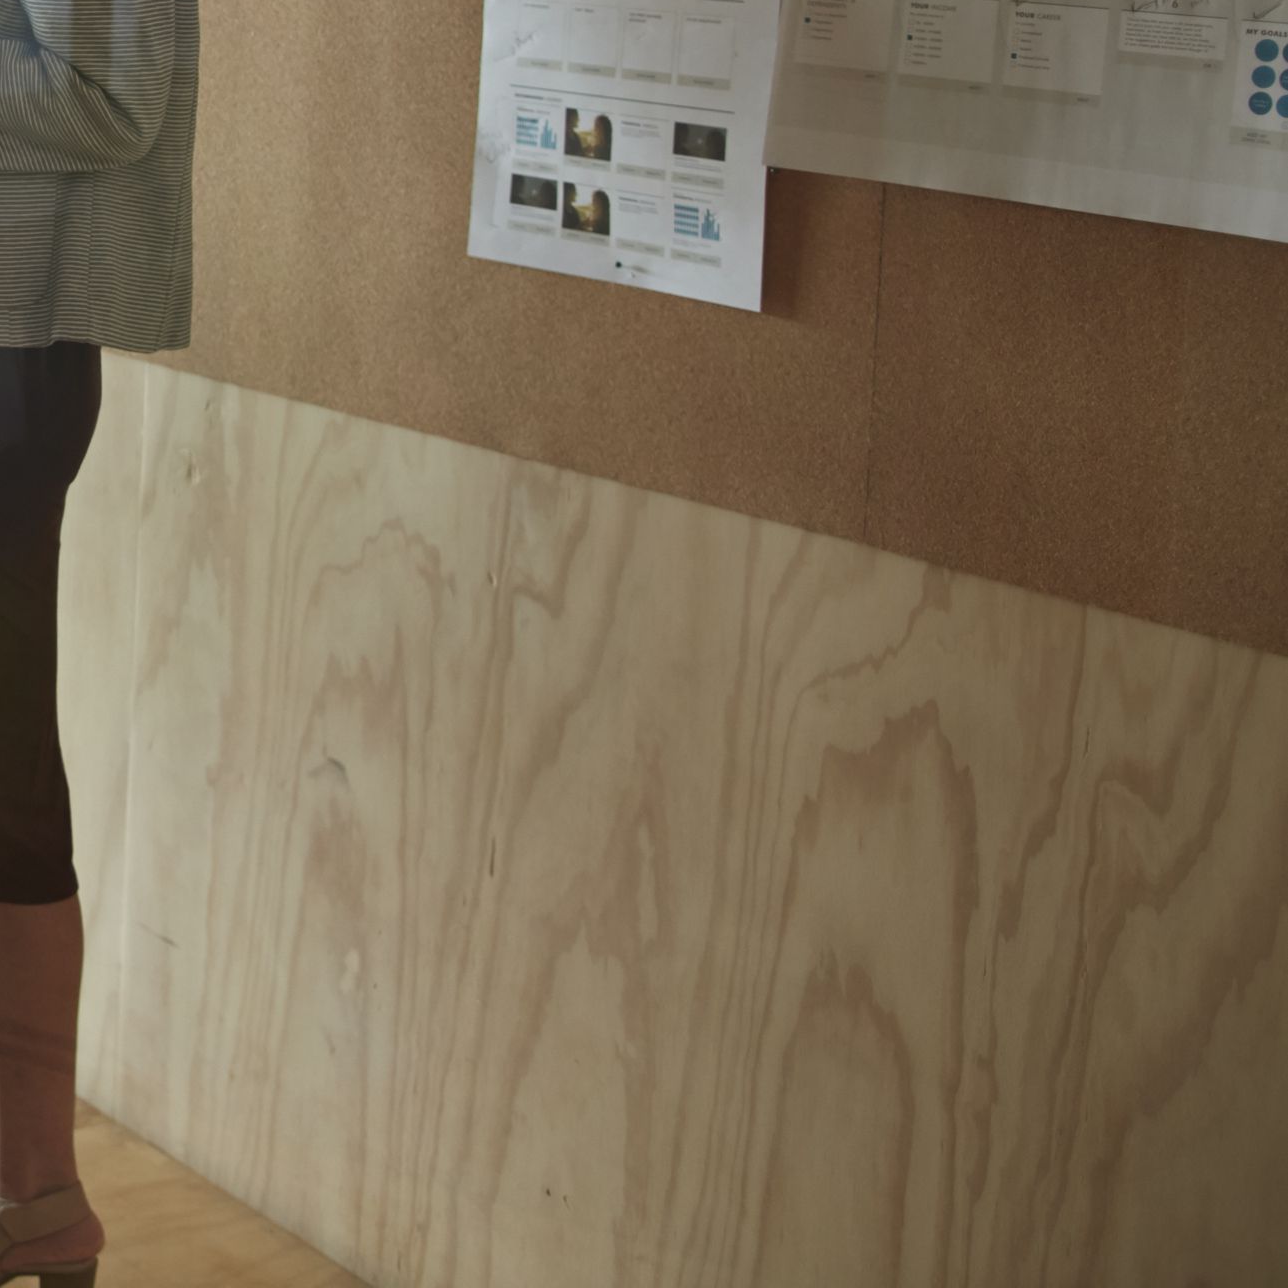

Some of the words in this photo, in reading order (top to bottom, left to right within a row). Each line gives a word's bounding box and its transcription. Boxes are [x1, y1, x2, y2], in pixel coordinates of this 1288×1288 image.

[911, 2, 929, 10] YOUR
[1171, 0, 1179, 8] 6
[1016, 11, 1035, 19] YOUR
[1036, 13, 1061, 21] CAREER
[1246, 28, 1259, 36] MY
[1261, 29, 1288, 39] GOALS
